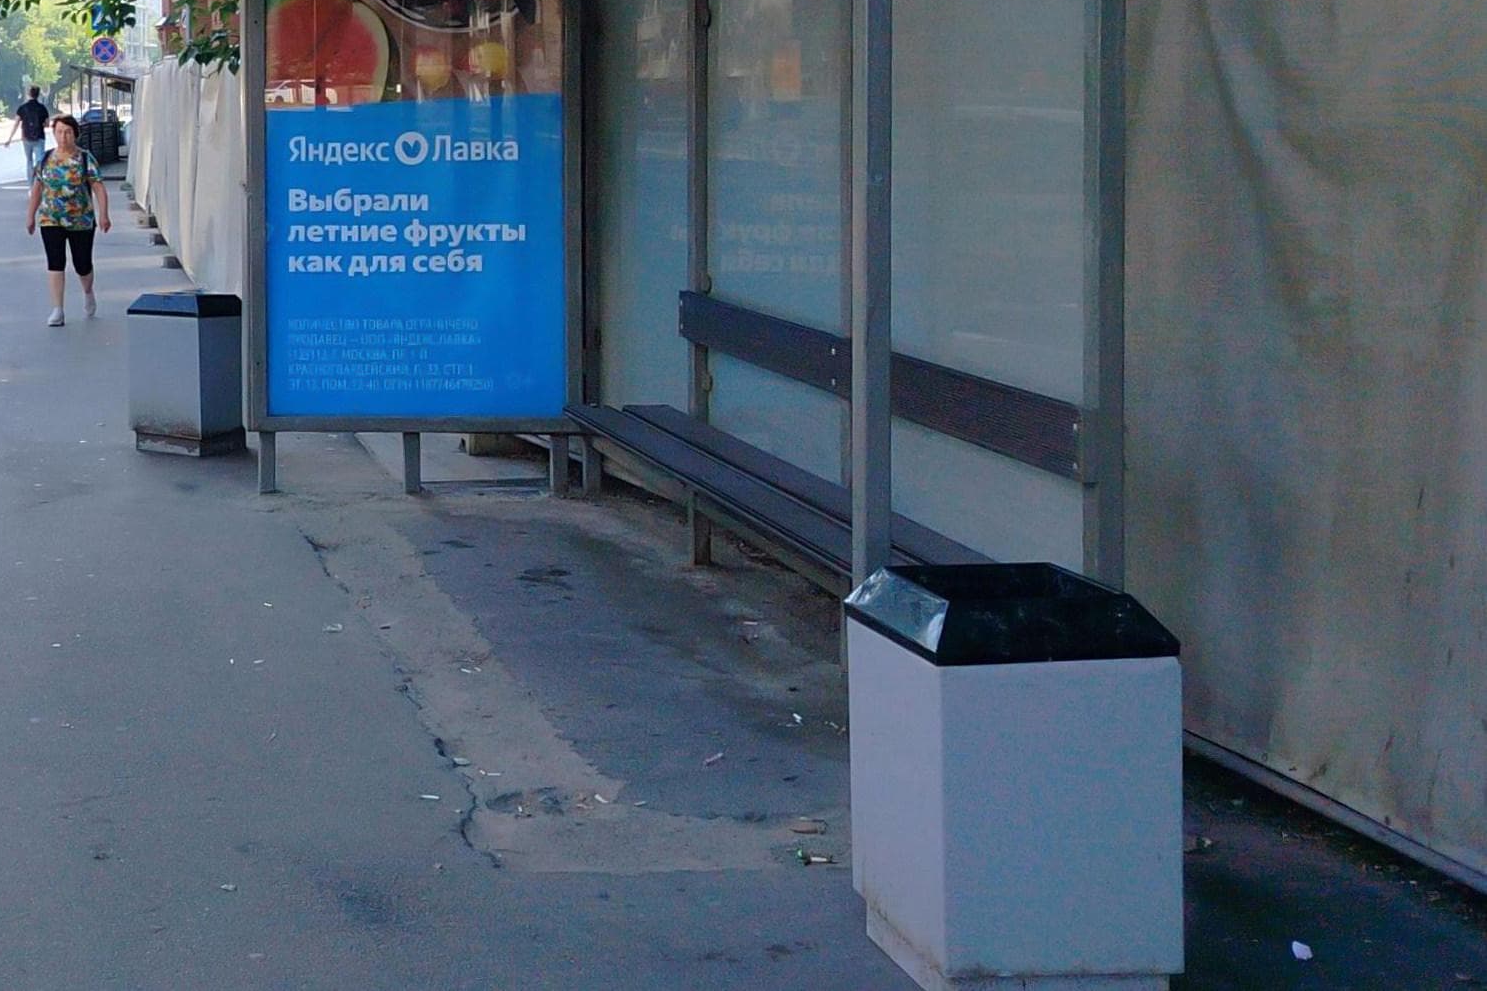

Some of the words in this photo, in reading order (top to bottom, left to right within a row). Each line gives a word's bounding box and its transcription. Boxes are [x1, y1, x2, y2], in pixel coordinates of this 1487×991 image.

[289, 136, 389, 165] Яндекс
[432, 135, 519, 161] Лавка
[289, 188, 429, 217] Выбрали
[288, 224, 397, 242] летние
[404, 218, 526, 247] фрукты
[288, 255, 342, 272] как
[348, 255, 406, 276] для
[412, 249, 483, 272] себя
